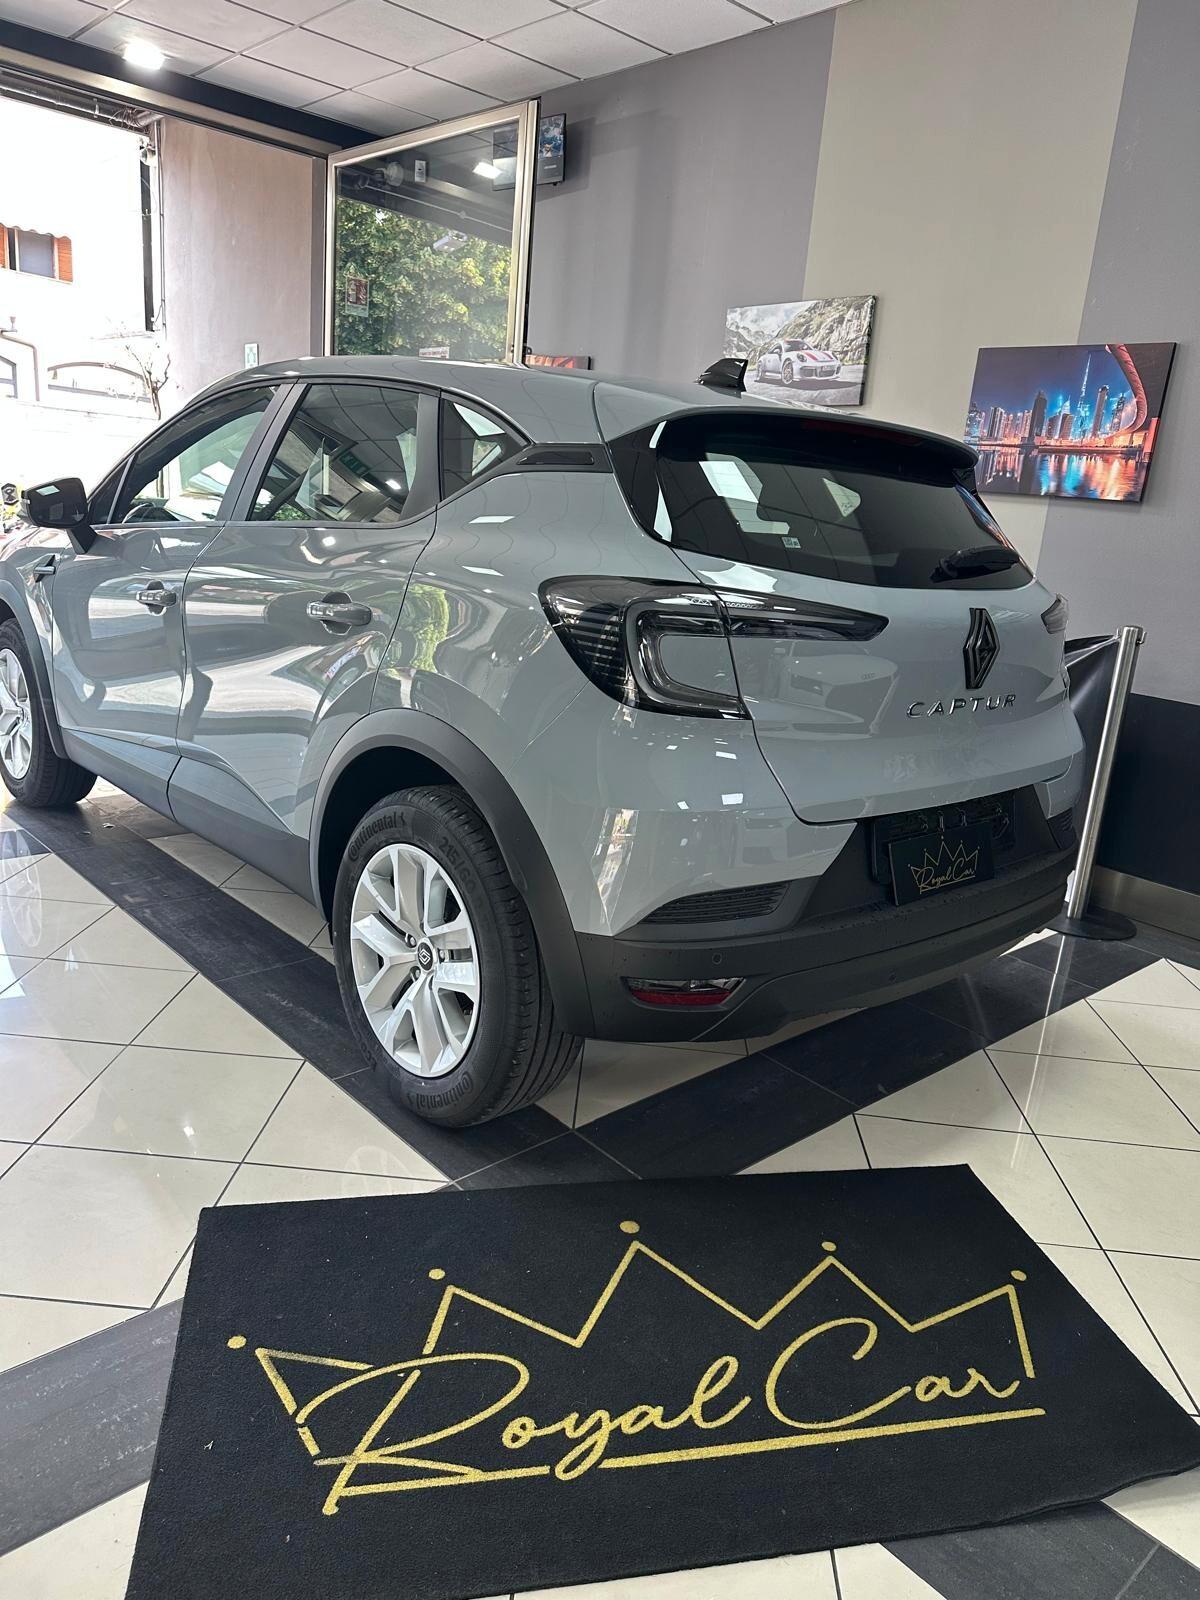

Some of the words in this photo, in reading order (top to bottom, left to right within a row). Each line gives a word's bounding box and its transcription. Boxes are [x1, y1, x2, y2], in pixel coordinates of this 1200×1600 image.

[907, 695, 1016, 718] CAPTUR
[916, 866, 953, 894] Royal
[952, 858, 975, 881] Car
[296, 1353, 752, 1515] Royal
[766, 1317, 1020, 1429] Car
